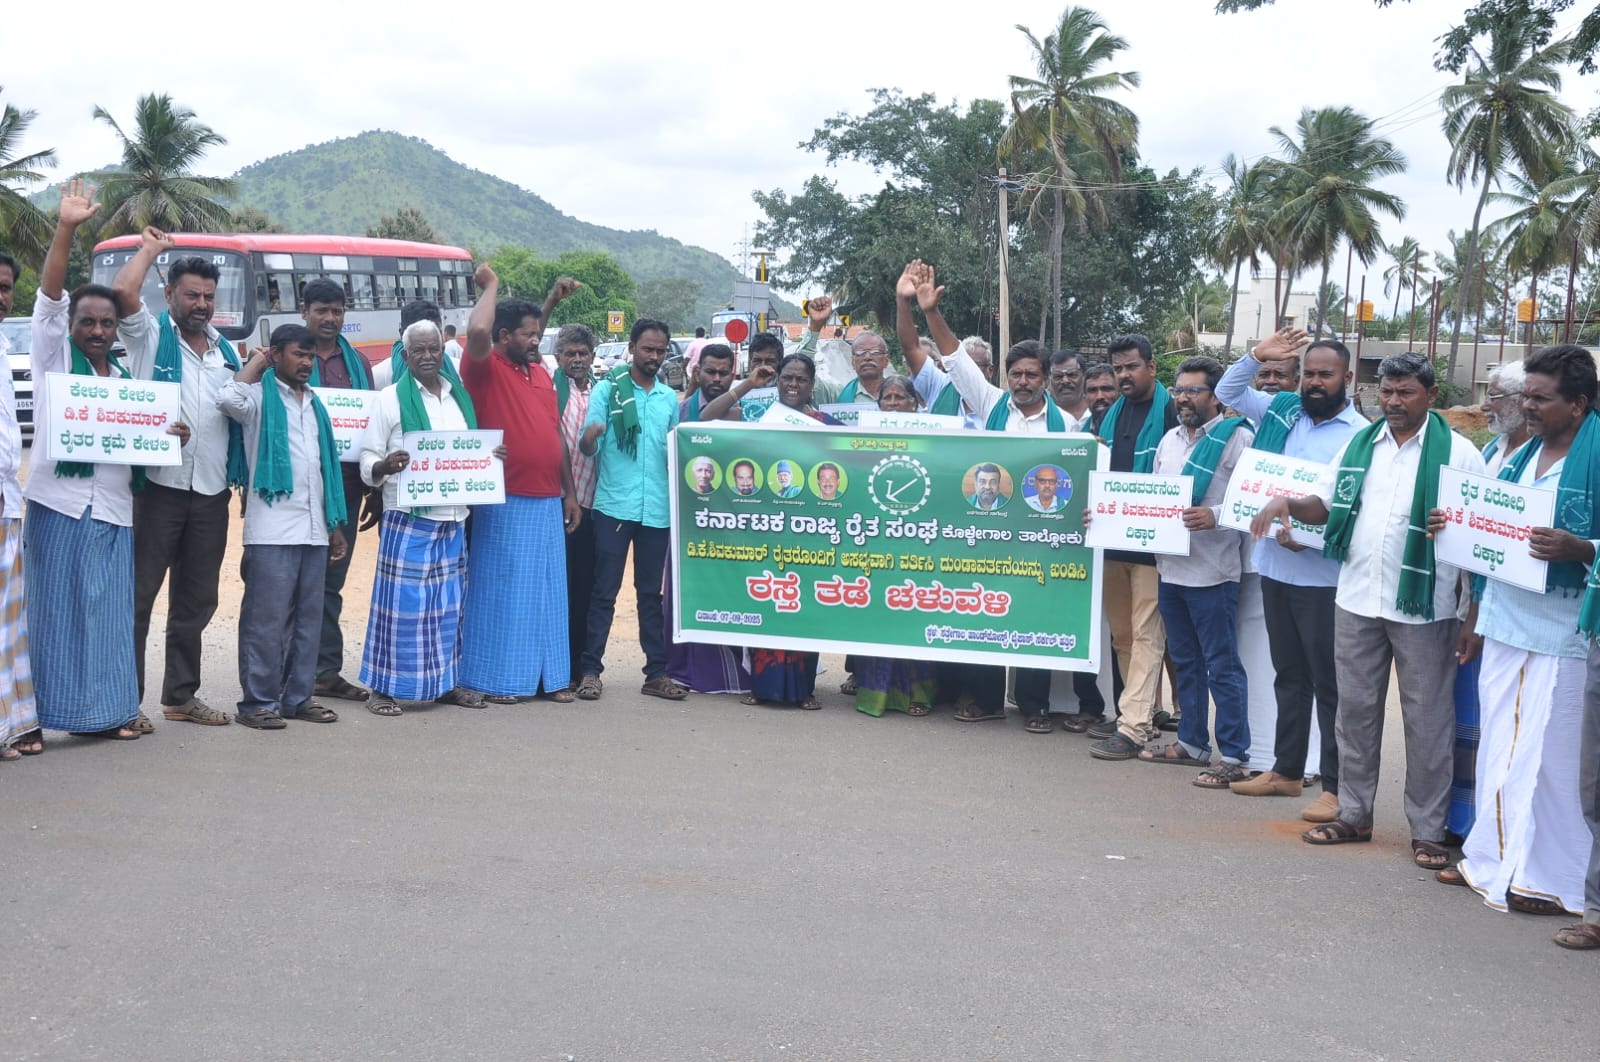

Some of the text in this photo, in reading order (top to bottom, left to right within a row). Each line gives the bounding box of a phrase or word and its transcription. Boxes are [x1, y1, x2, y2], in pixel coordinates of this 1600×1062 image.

[341, 322, 361, 333] SRTC
[70, 382, 156, 403] ಕೇಳಲಿ ಕೇಳಲಿ
[64, 406, 168, 426] ಡಿ.ಕೆ ಶಿವಕುಮಾರ್
[60, 430, 170, 455] ರೈತರ ಕ್ಷಮೆ ಕೇಳಲಿ
[418, 435, 482, 451] ಕೇಳಲಿ ಕೇಳಲಿ
[411, 456, 491, 472] ಡಿ.ಕೆ ಶಿವಕುಮಾರ್
[1255, 458, 1319, 484] ಕೇಳಲಿ ಕೇಳ
[408, 478, 496, 500] ರೈತರ ಕ್ಷಮೆ ಕೇಳಲಿ
[1461, 479, 1525, 514] ರೈತ ವಿರೋಧಿ
[1096, 501, 1116, 515] ಡಿ.ಕೆ
[695, 508, 1082, 547] ಕರ್ನಾಟಕ ರಾಜ್ಯ ರೈತ ಸಂಘ ಕೊಳ್ಳೇಗಾಲ ತಾಲ್ಲೋಕು
[1126, 526, 1156, 546] ದಿಕ್ಕಾರ
[1469, 511, 1532, 541] ಶಿವಕುಮಾರ್
[773, 544, 836, 571] ರೈತರೊಂದಿಗೆ
[840, 550, 895, 576] ಅಸಭ್ಯವಾಗಿ
[899, 553, 935, 572] ವರ್ತಿಸಿ
[940, 555, 1046, 585] ದುಂಡಾವರ್ತನೆಯನ್ನು
[1050, 561, 1087, 581] ಖಂಡಿಸಿ
[1473, 543, 1504, 571] ದಿಕ್ಕಾರ
[746, 570, 1012, 616] ರಸ್ತೆ ತಡೆ ಚಳುವಳಿ
